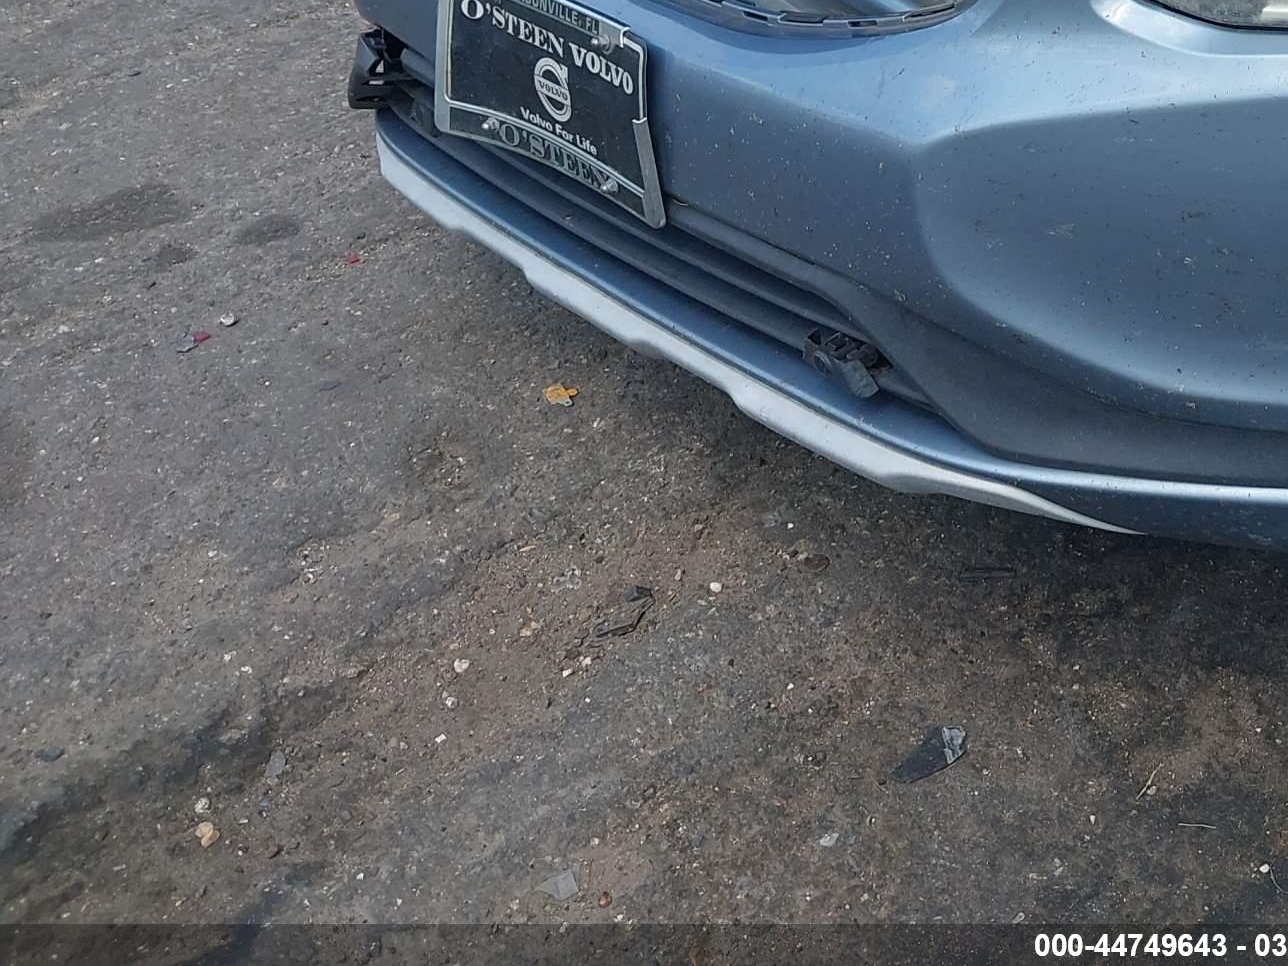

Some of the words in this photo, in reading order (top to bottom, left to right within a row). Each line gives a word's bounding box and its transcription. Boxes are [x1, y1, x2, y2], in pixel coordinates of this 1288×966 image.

[585, 17, 598, 35] FL
[538, 79, 569, 101] VOLVO
[568, 42, 634, 95] VOLVO
[520, 106, 553, 131] Volvo
[555, 123, 574, 143] For
[576, 134, 598, 155] Life
[499, 123, 609, 189] O'STEEN
